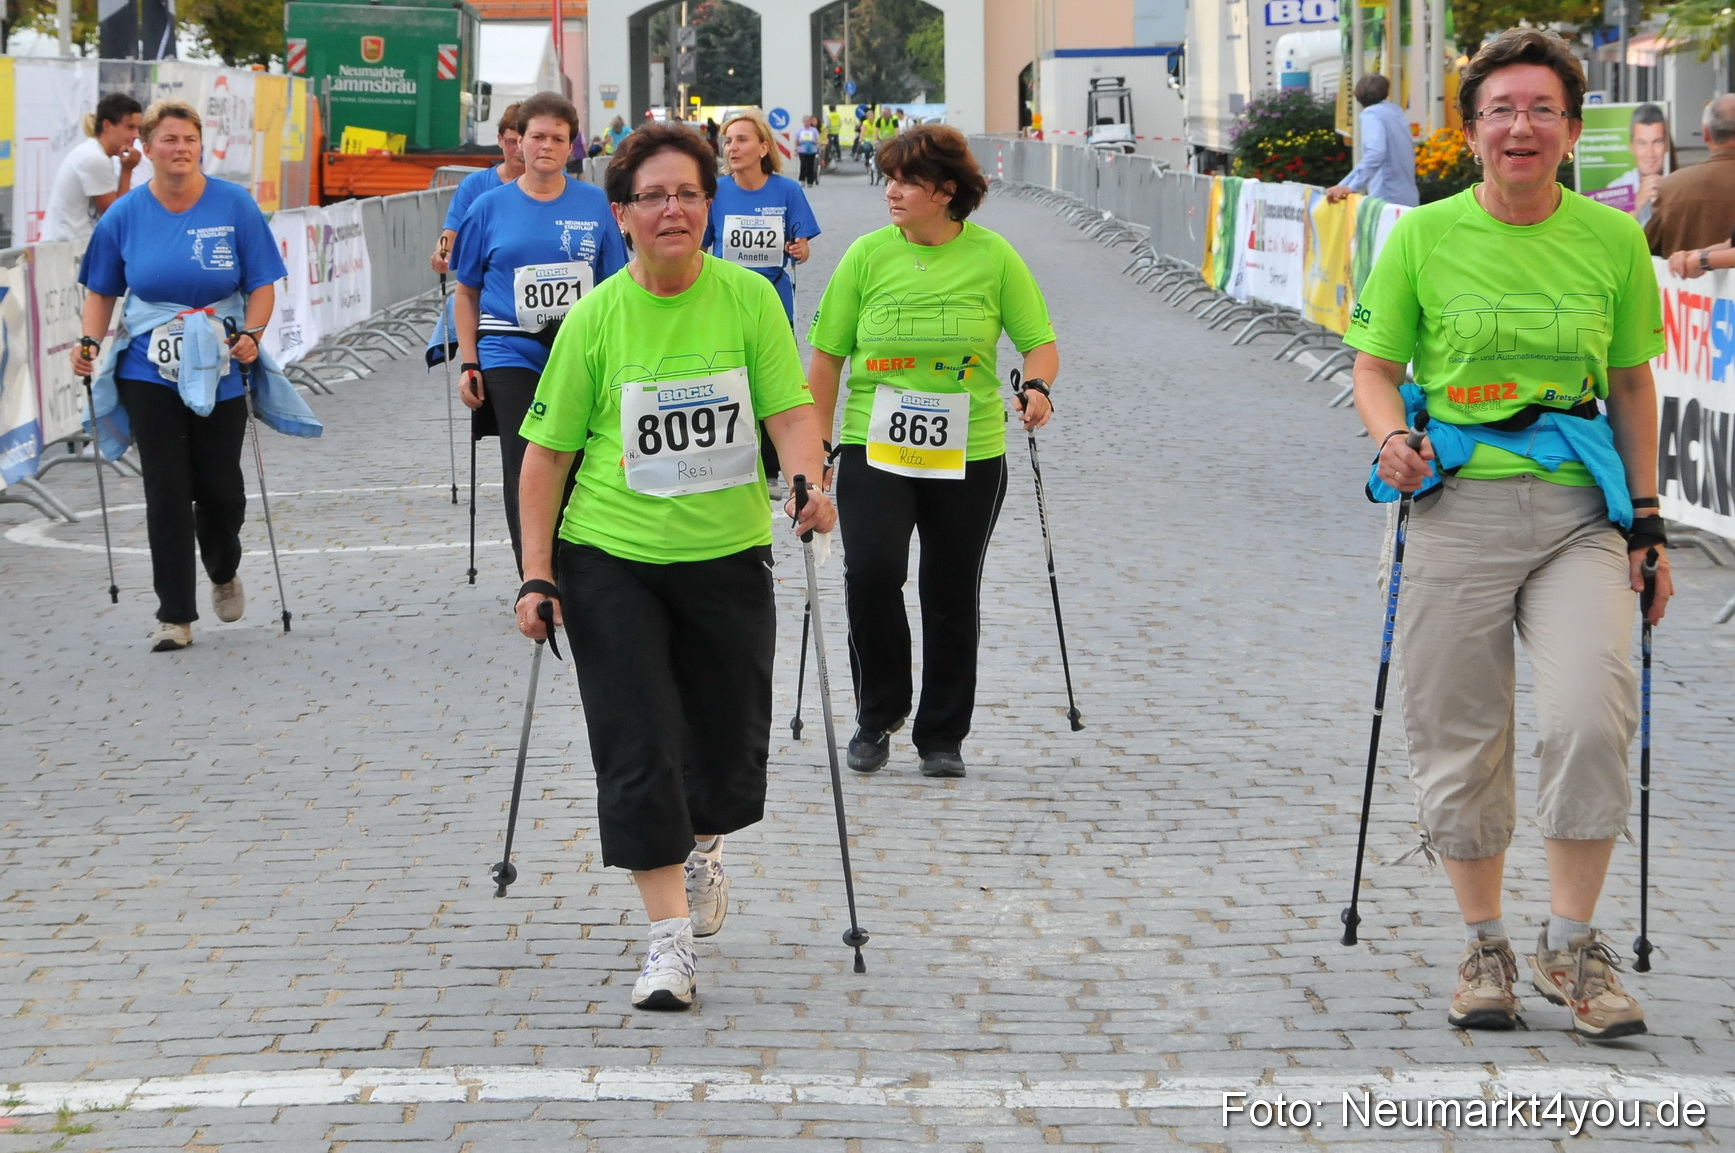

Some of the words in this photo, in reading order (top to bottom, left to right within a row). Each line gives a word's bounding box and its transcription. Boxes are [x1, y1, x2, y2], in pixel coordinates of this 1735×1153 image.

[1264, 0, 1339, 26] BO
[338, 64, 406, 78] Neumarkter
[730, 229, 777, 249] 8042
[738, 252, 769, 261] Annette
[536, 268, 568, 277] BOCK
[524, 280, 582, 309] 8021
[536, 312, 568, 325] Claud
[862, 292, 985, 336] OPF
[1353, 302, 1371, 325] Ba
[1440, 293, 1609, 355] OPF
[866, 357, 916, 372] MERZ
[657, 384, 714, 403] BOCK
[901, 394, 941, 407] BOCK
[1447, 382, 1518, 405] MERZ
[637, 402, 740, 456] 8097
[888, 411, 949, 447] 863
[899, 446, 926, 466] Rita
[677, 458, 714, 480] Resi
